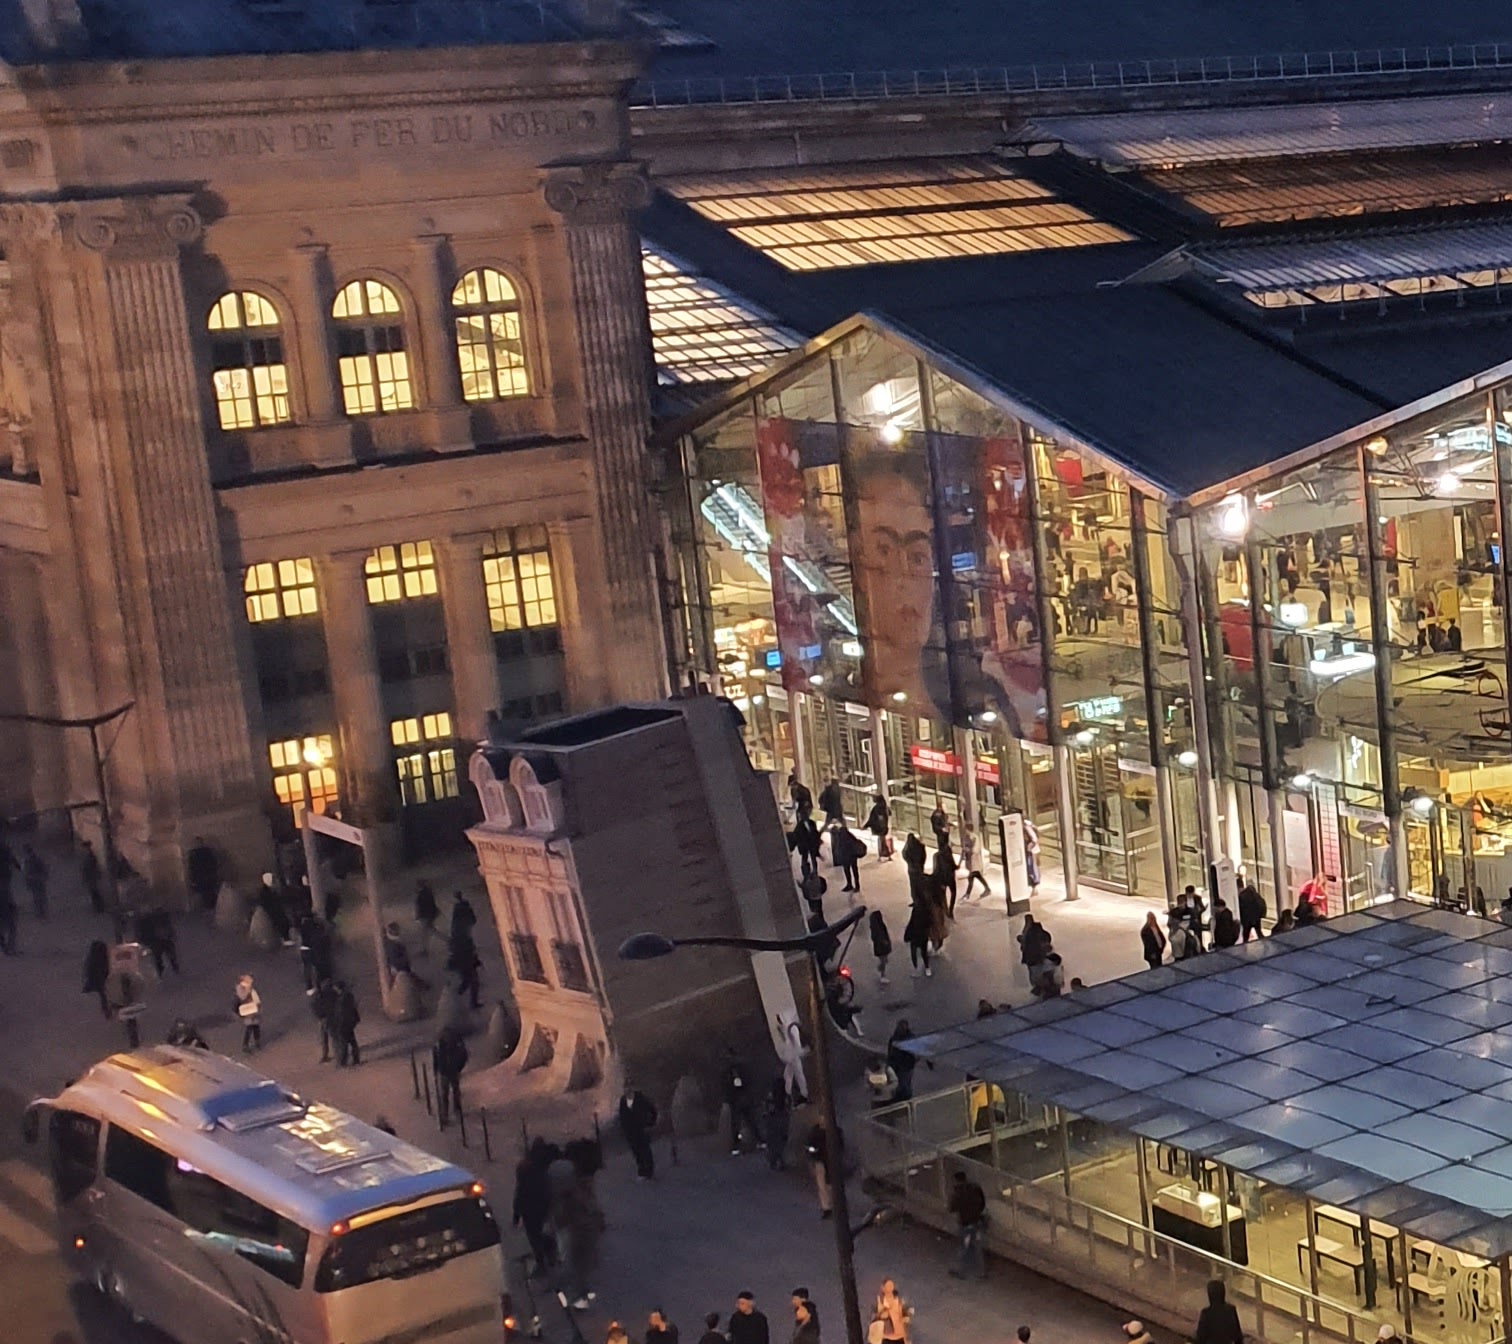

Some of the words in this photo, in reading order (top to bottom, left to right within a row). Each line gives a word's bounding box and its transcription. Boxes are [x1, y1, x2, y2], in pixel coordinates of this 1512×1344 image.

[146, 126, 276, 159] CHEMIN
[290, 122, 336, 153] DE
[351, 117, 418, 148] FER
[431, 114, 473, 144] DU
[488, 109, 572, 140] NORD
